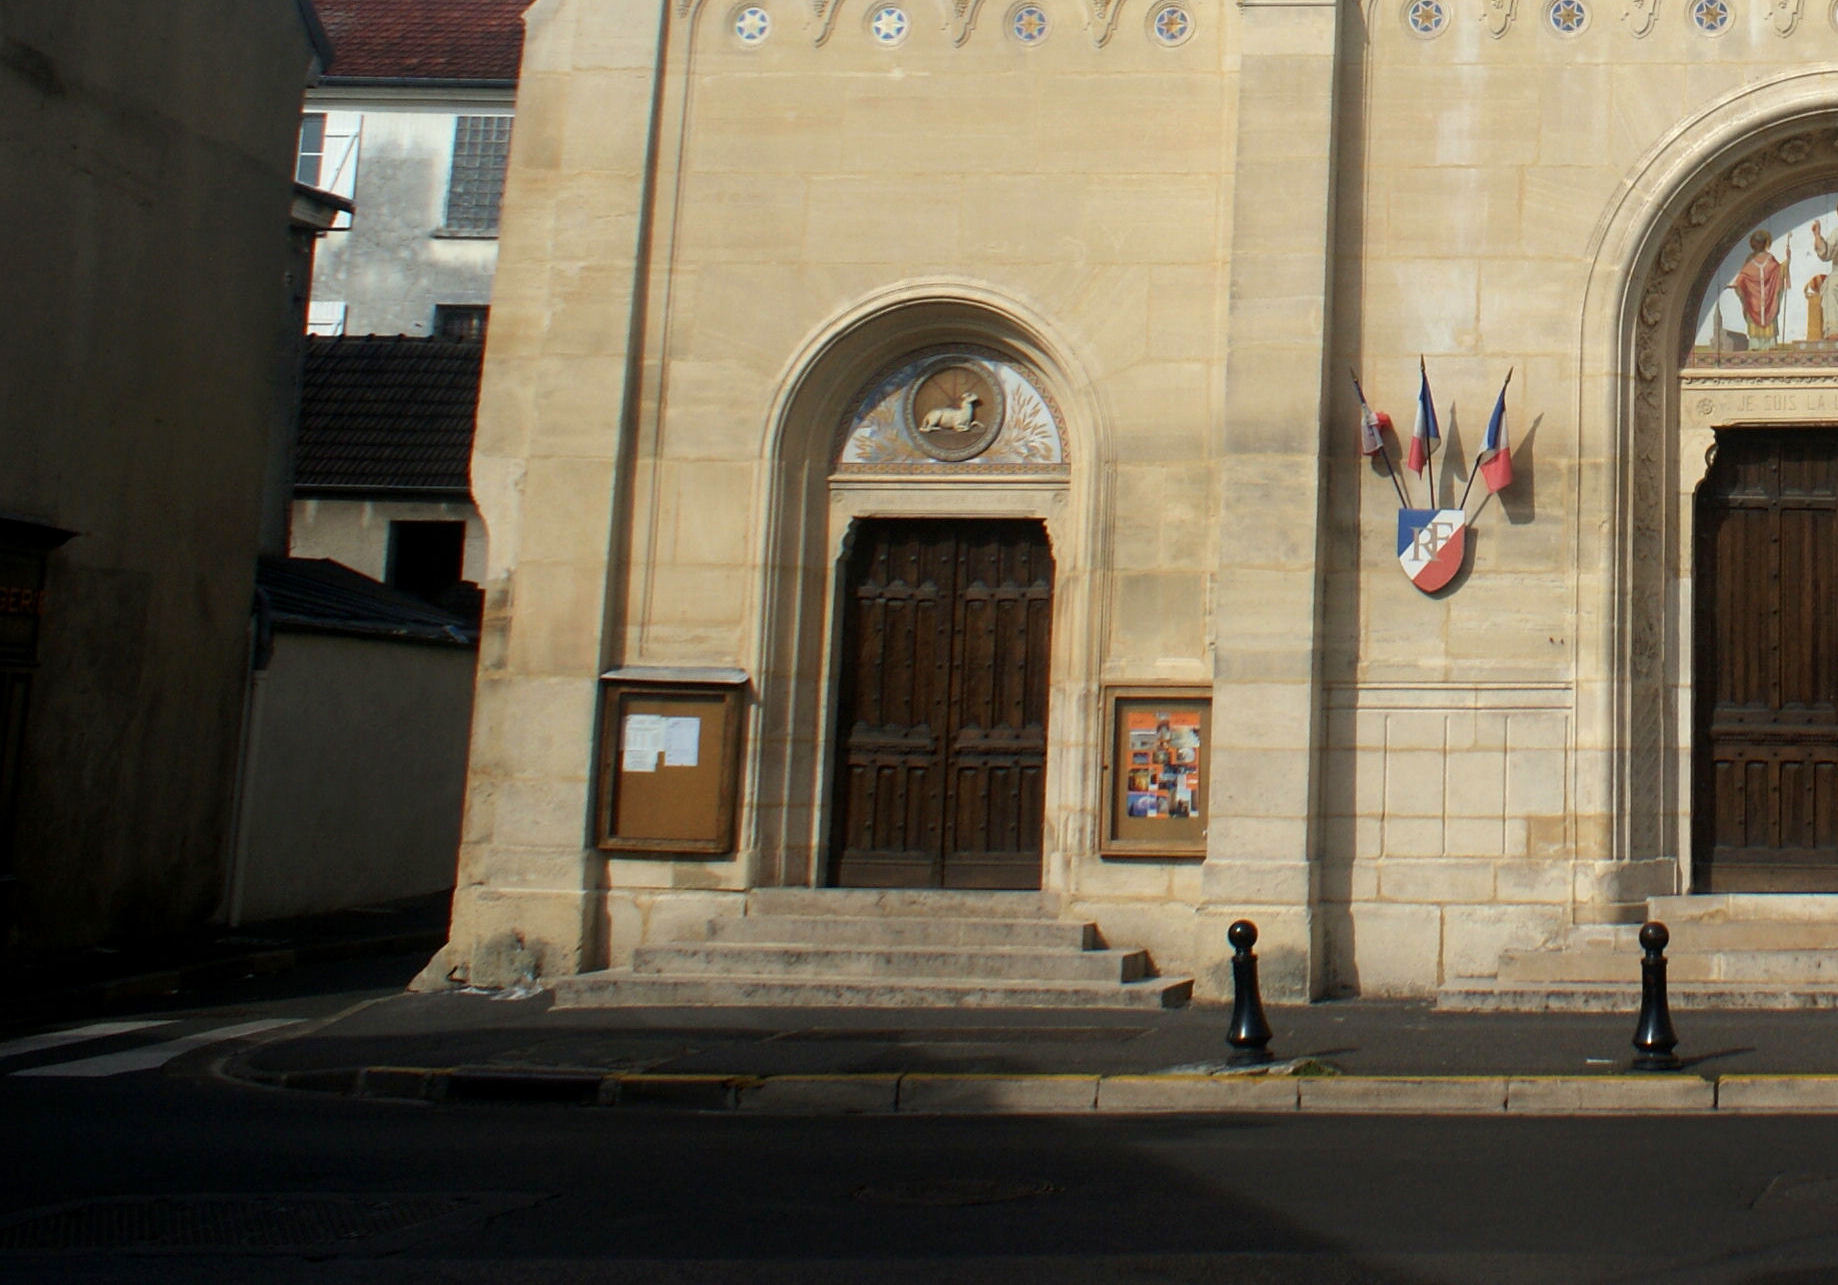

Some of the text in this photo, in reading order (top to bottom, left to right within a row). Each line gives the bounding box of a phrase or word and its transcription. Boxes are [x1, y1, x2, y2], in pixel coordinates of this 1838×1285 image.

[1737, 394, 1753, 412] JE
[1764, 394, 1796, 411] SUIS
[1807, 393, 1826, 411] LA
